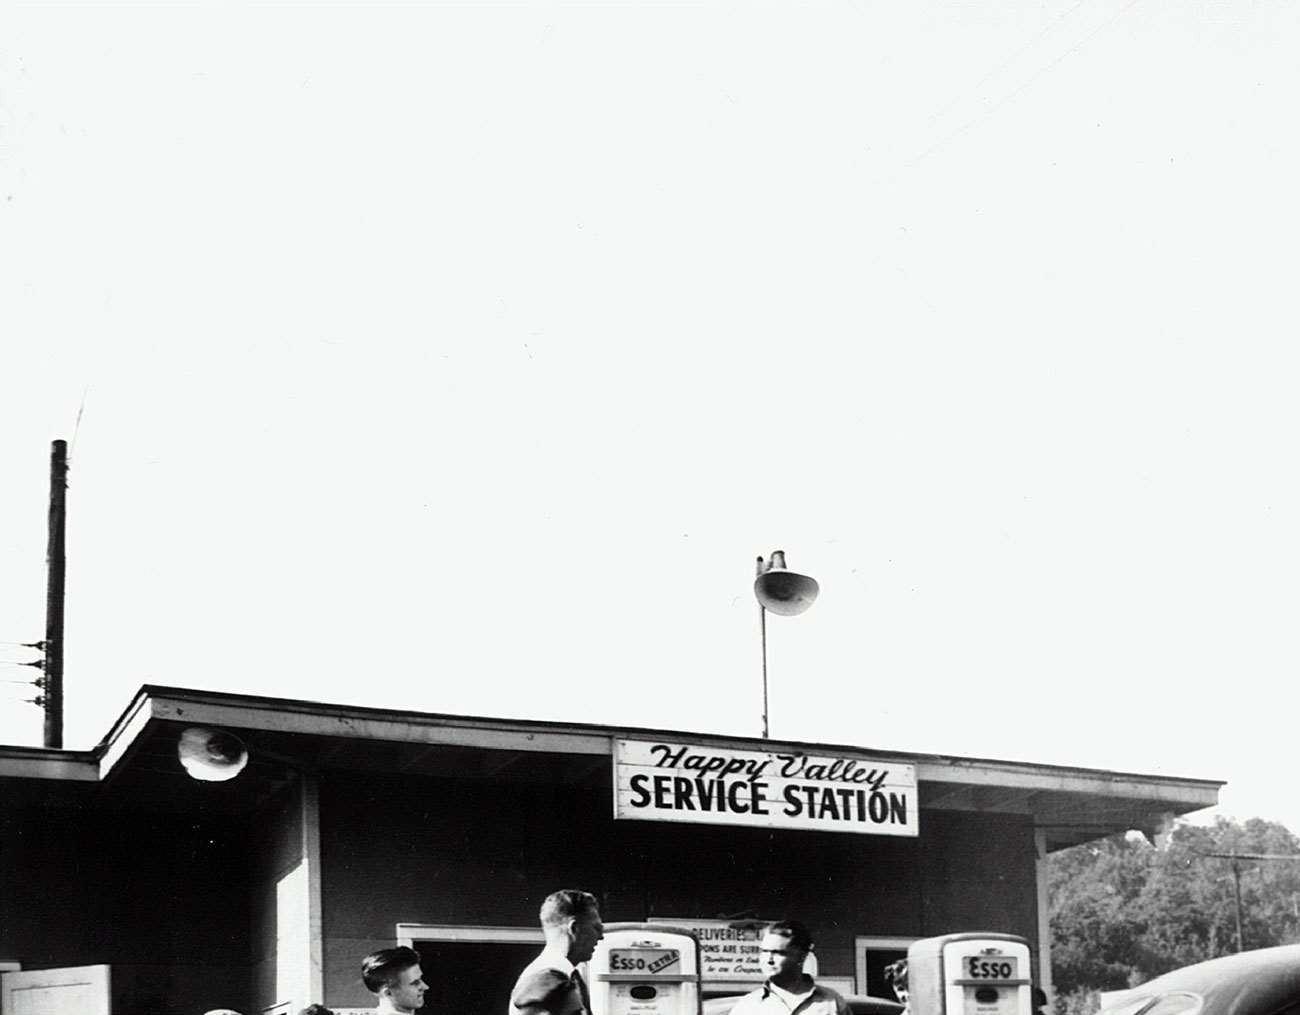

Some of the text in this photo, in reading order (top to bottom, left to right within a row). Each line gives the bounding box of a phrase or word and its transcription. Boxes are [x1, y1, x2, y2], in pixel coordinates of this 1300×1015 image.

[650, 745, 889, 791] Happy Valley
[630, 774, 907, 825] SERVICE STATION
[647, 949, 680, 972] EXTRA
